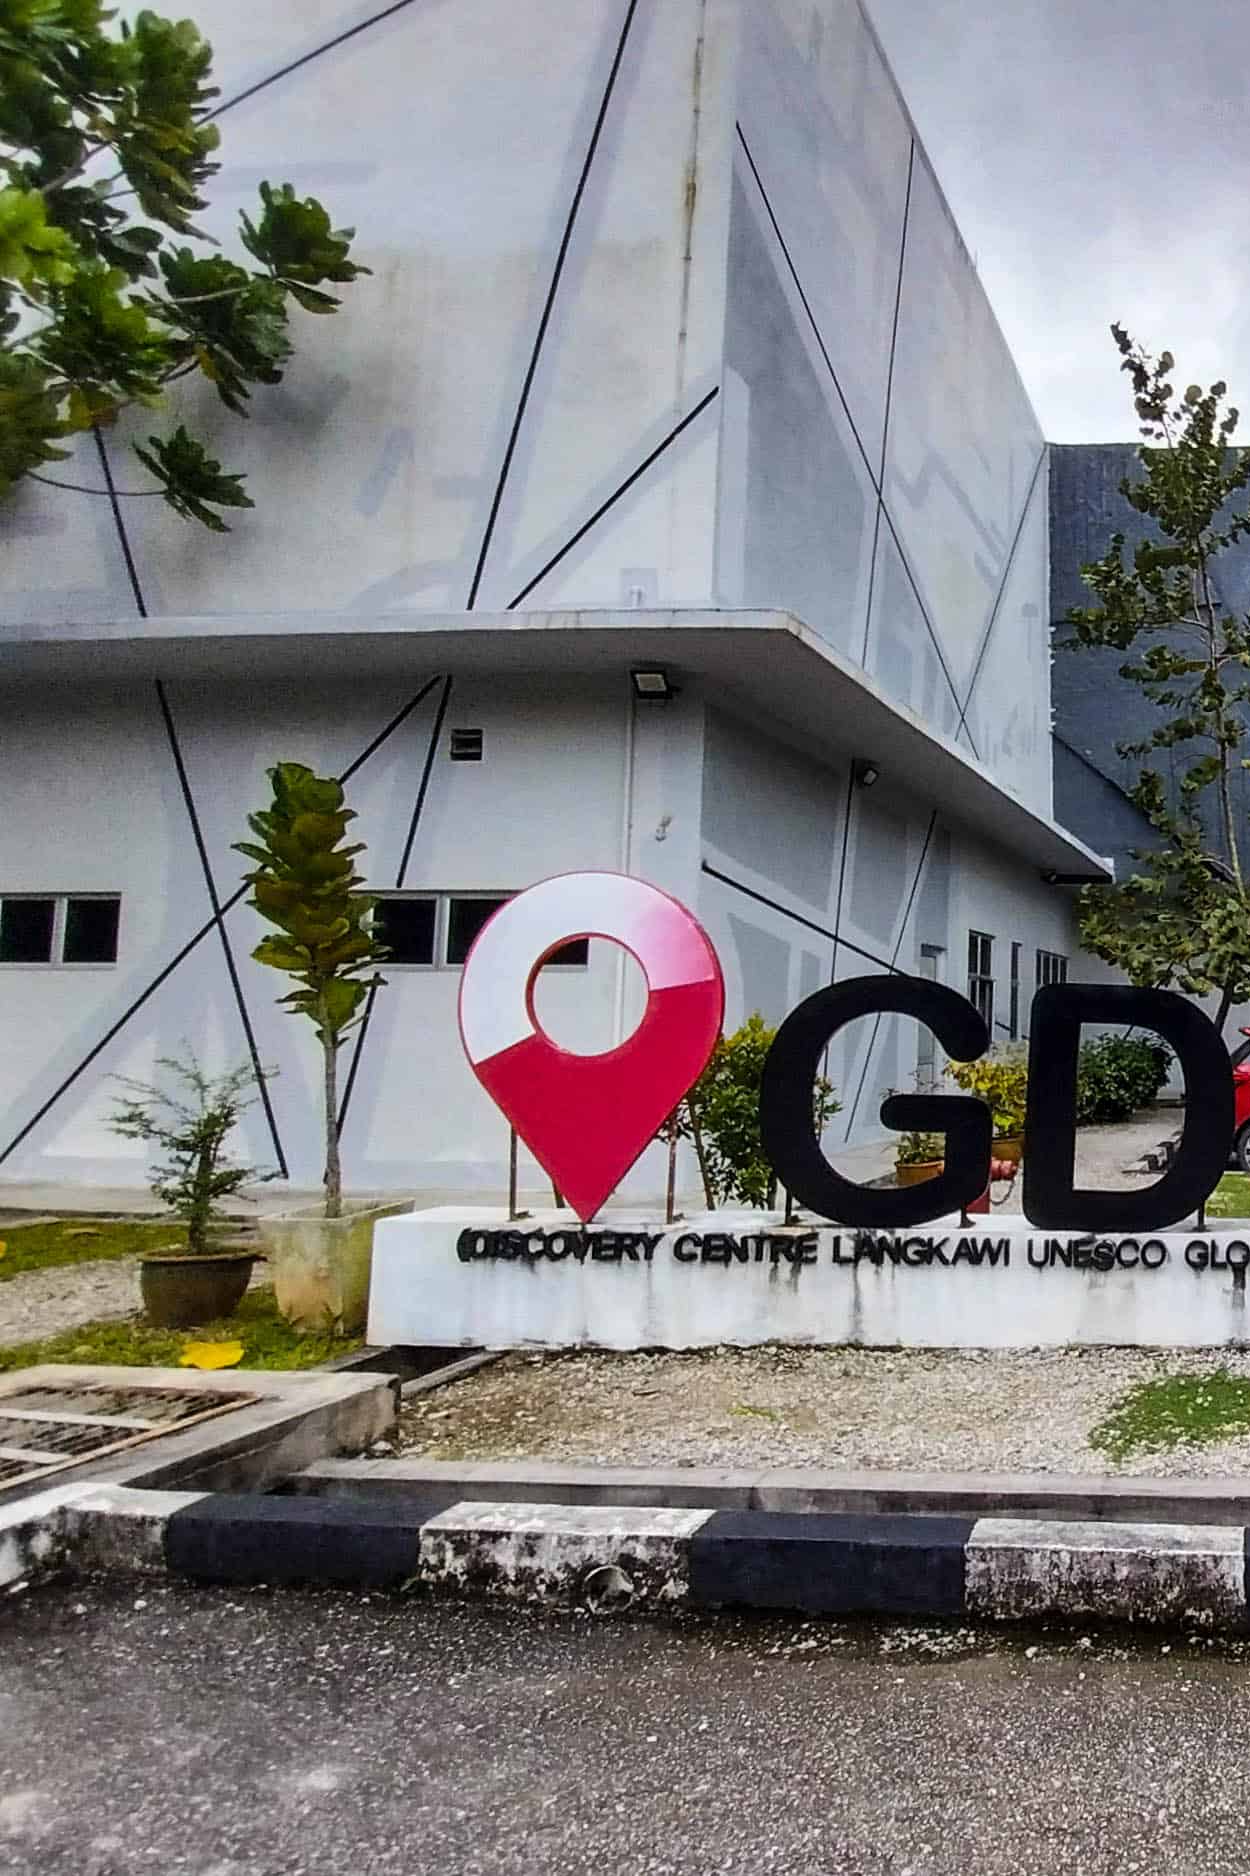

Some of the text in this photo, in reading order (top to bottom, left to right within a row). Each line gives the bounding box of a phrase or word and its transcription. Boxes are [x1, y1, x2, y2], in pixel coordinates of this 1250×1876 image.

[674, 1230, 818, 1264] CENTRE
[832, 1234, 1010, 1267] LANGKAWI
[1027, 1236, 1167, 1271] UNESCO
